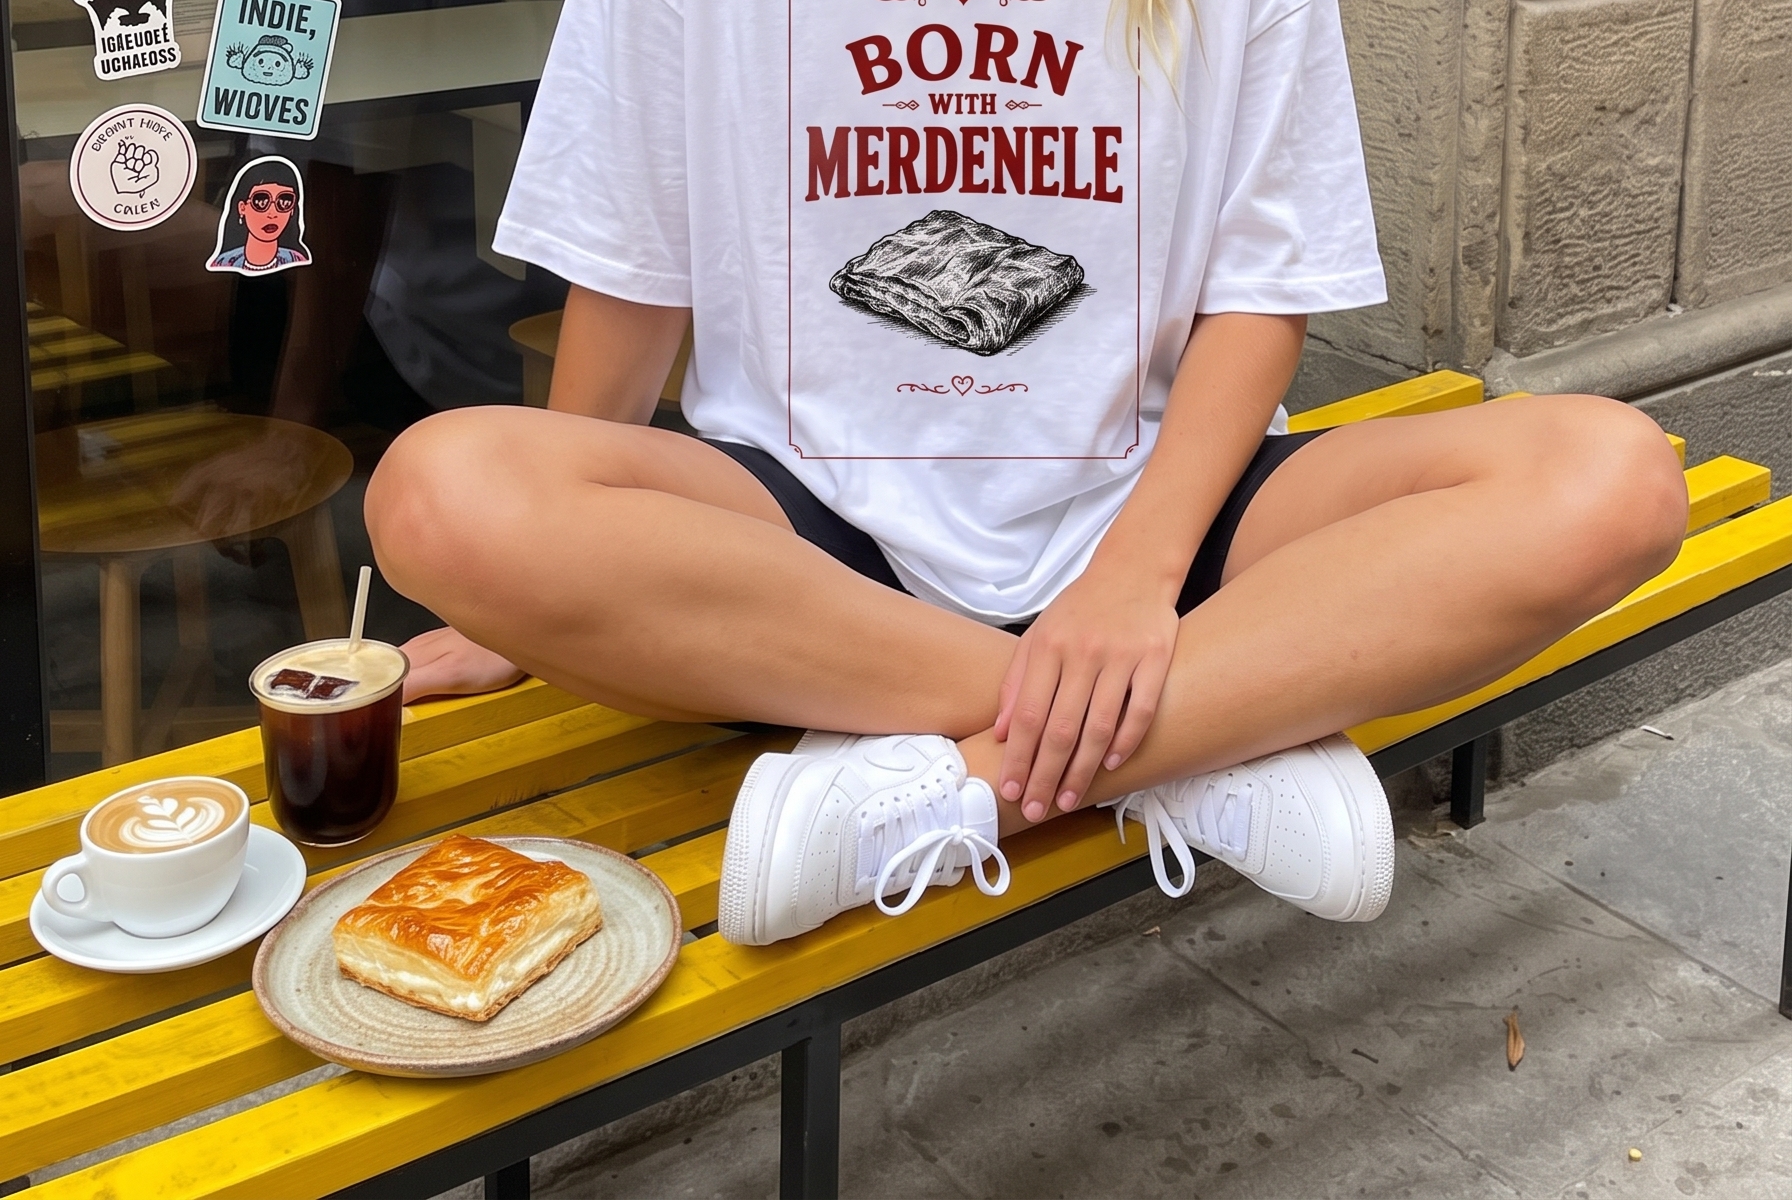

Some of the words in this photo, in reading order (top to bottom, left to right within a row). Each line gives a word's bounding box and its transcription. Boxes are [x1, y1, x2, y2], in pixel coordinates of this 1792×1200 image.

[100, 47, 177, 75] UCHAEOSS
[845, 23, 1084, 96] BORN
[928, 93, 997, 115] WITH
[804, 125, 1123, 204] MERDENELE
